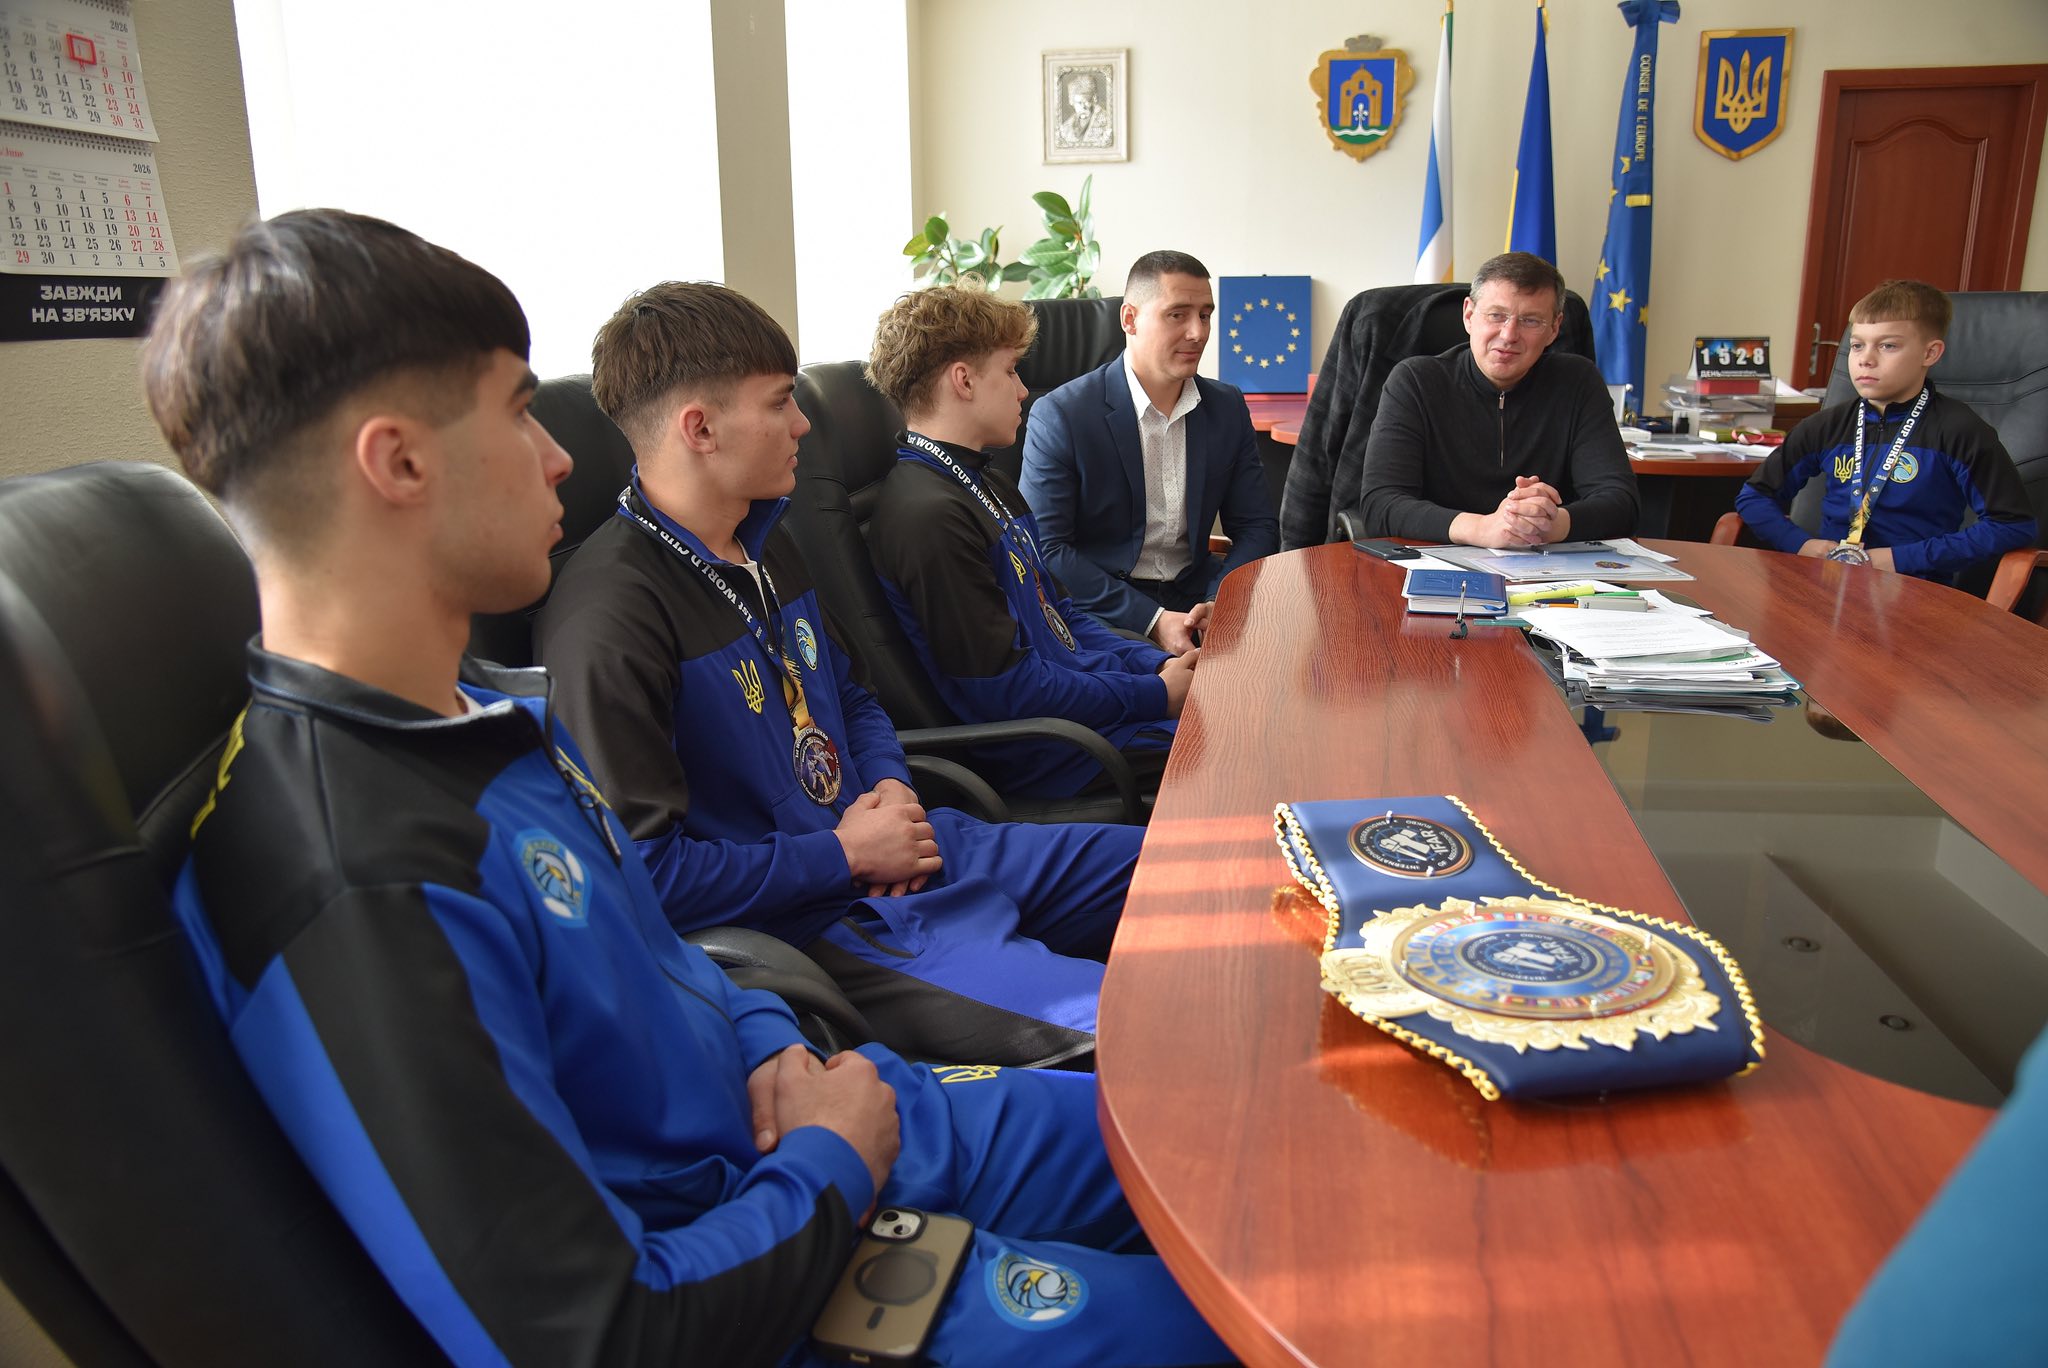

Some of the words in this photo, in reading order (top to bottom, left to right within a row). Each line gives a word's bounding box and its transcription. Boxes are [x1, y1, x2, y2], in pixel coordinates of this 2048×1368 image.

[110, 20, 128, 33] 2026
[23, 32, 37, 47] 29
[100, 51, 106, 63] 2
[122, 56, 128, 68] 3
[30, 51, 37, 64] 6
[54, 56, 60, 68] 7
[102, 66, 108, 78] 9
[122, 71, 134, 84] 10
[4, 62, 18, 76] 12
[30, 68, 44, 82] 13
[56, 73, 68, 86] 14
[80, 78, 92, 91] 15
[103, 83, 115, 96] 16
[124, 87, 136, 100] 17
[8, 80, 22, 94] 19
[34, 84, 48, 98] 20
[59, 90, 72, 104] 21
[83, 94, 96, 107] 22
[106, 98, 119, 112] 23
[128, 102, 140, 116] 24
[1638, 98, 1648, 112] DE
[12, 97, 28, 112] 26
[38, 102, 52, 116] 27
[64, 106, 78, 120] 28
[88, 110, 101, 123] 29
[110, 114, 124, 127] 30
[132, 118, 144, 129] 31
[132, 164, 152, 174] 2026
[30, 184, 38, 198] 2
[56, 186, 62, 200] 3
[80, 190, 86, 202] 4
[102, 192, 108, 204] 5
[124, 194, 130, 206] 6
[146, 196, 152, 208] 7
[8, 198, 16, 212] 8
[34, 201, 40, 214] 9
[56, 204, 68, 216] 10
[80, 206, 92, 218] 11
[102, 208, 114, 220] 12
[124, 210, 136, 222] 13
[146, 211, 158, 224] 14
[8, 216, 22, 230] 15
[34, 218, 48, 232] 16
[60, 220, 72, 233] 17
[83, 222, 96, 234] 18
[106, 223, 118, 236] 19
[128, 225, 140, 237] 20
[150, 226, 162, 238] 21
[12, 233, 26, 247] 22
[38, 234, 52, 248] 23
[62, 236, 76, 250] 24
[86, 238, 98, 250] 25
[109, 239, 122, 252] 26
[130, 240, 142, 252] 27
[152, 241, 164, 252] 28
[16, 250, 30, 264] 29
[42, 252, 54, 264] 30
[70, 253, 76, 266] 1
[92, 254, 100, 266] 2
[116, 254, 122, 267] 3
[138, 256, 144, 268] 4
[159, 256, 166, 268] 5
[40, 286, 122, 302] ЗАВЖДИ
[32, 308, 60, 322] НА
[62, 307, 136, 322] ЗВ'ЯЗКУ
[1700, 347, 1765, 366] 1528
[1901, 418, 1915, 438] CUP
[1855, 427, 1863, 462] WORLD
[1882, 438, 1905, 470] RUKBO
[906, 434, 916, 444] 1st
[916, 437, 952, 466] WORLD
[952, 464, 971, 484] CUP
[970, 484, 1000, 520] RUKBO
[738, 602, 752, 623] 1st
[1420, 829, 1449, 856] IFAR
[1540, 941, 1580, 964] IFAR
